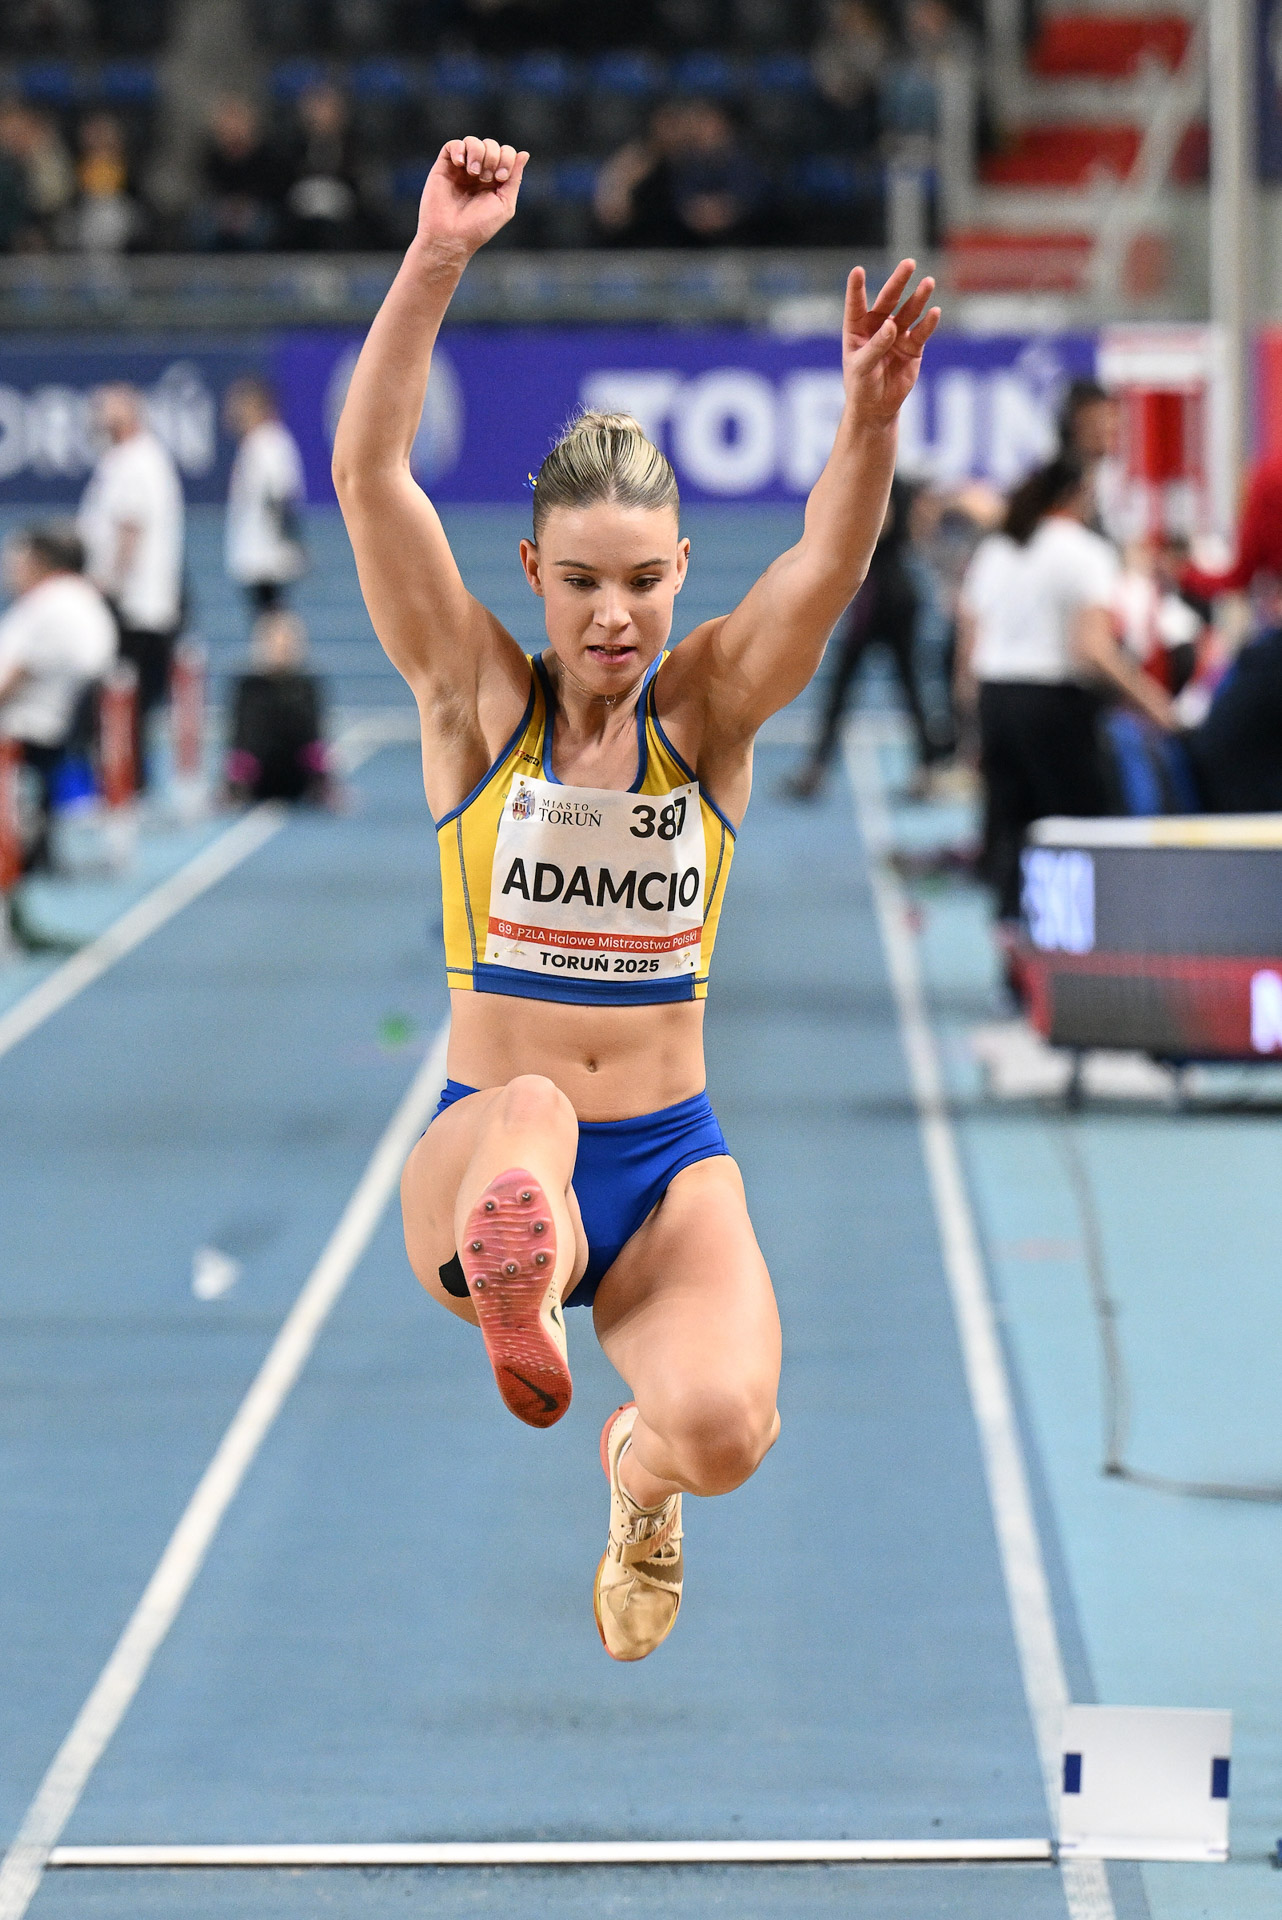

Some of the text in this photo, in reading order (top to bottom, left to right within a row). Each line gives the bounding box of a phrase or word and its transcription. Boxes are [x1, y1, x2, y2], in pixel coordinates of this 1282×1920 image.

[539, 808, 603, 827] TORUŃ
[542, 798, 589, 812] MIASTO
[629, 796, 687, 841] 387
[501, 857, 700, 912] ADAMCIO
[498, 922, 698, 950] 69. PZLA Halowe Mistrzostwa Polski
[540, 951, 660, 973] TORUŃ 2025
